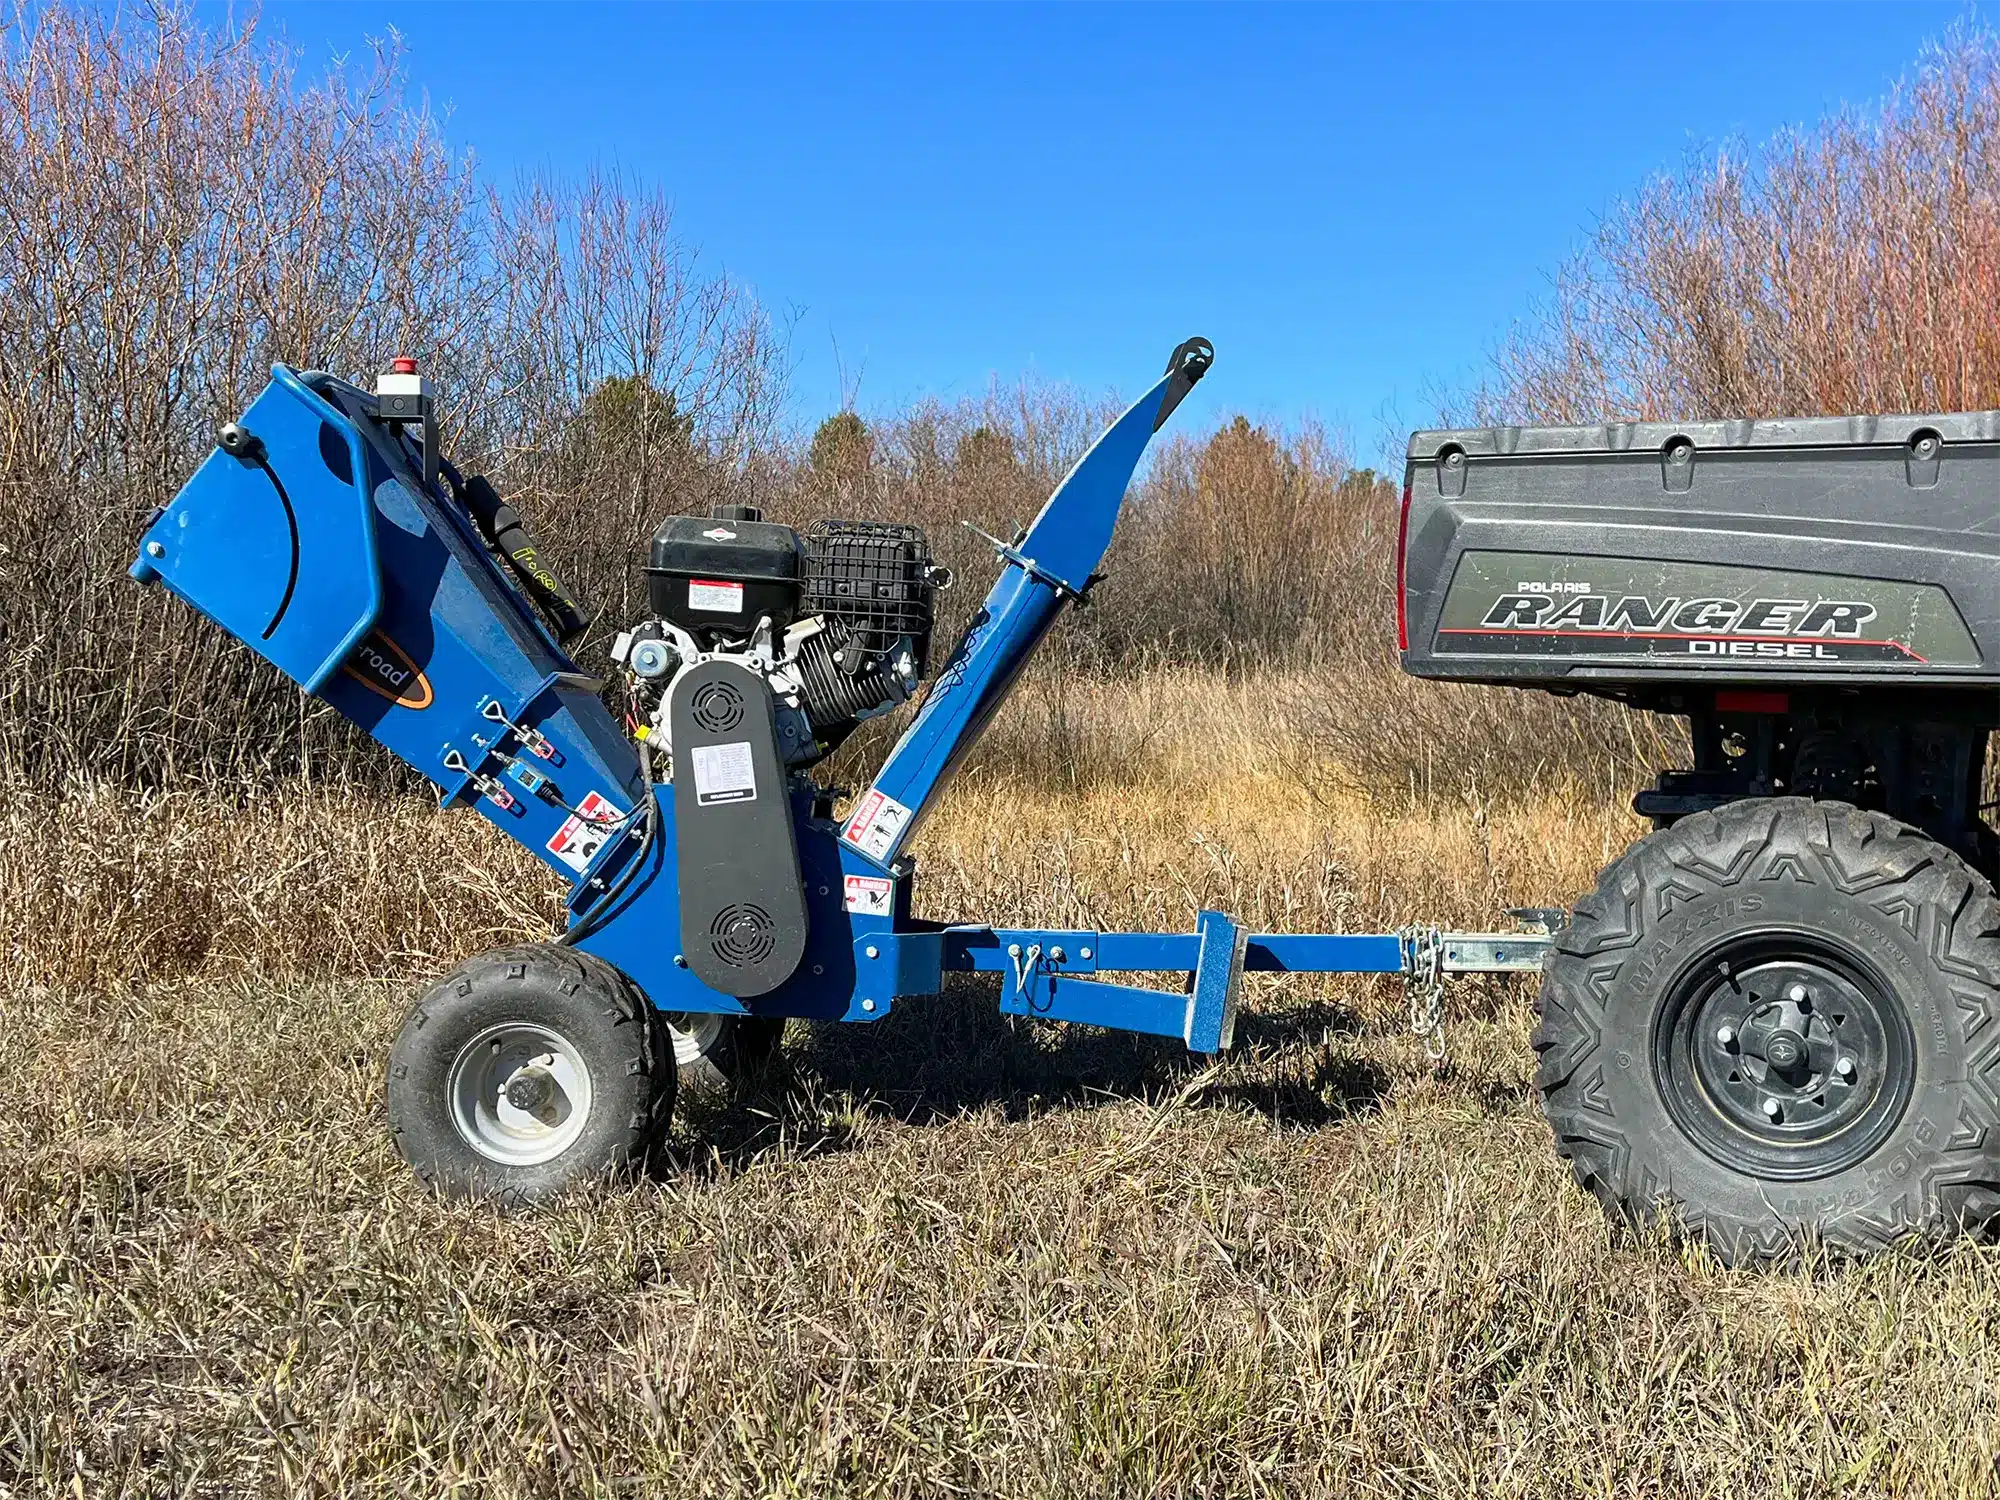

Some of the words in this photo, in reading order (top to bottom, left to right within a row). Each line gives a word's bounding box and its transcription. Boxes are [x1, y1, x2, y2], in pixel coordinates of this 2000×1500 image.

[1517, 581, 1591, 594] POLARIS
[1480, 593, 1878, 638] RANGER
[1688, 640, 1839, 659] DIESEL
[1629, 893, 1763, 992] MAXXIS
